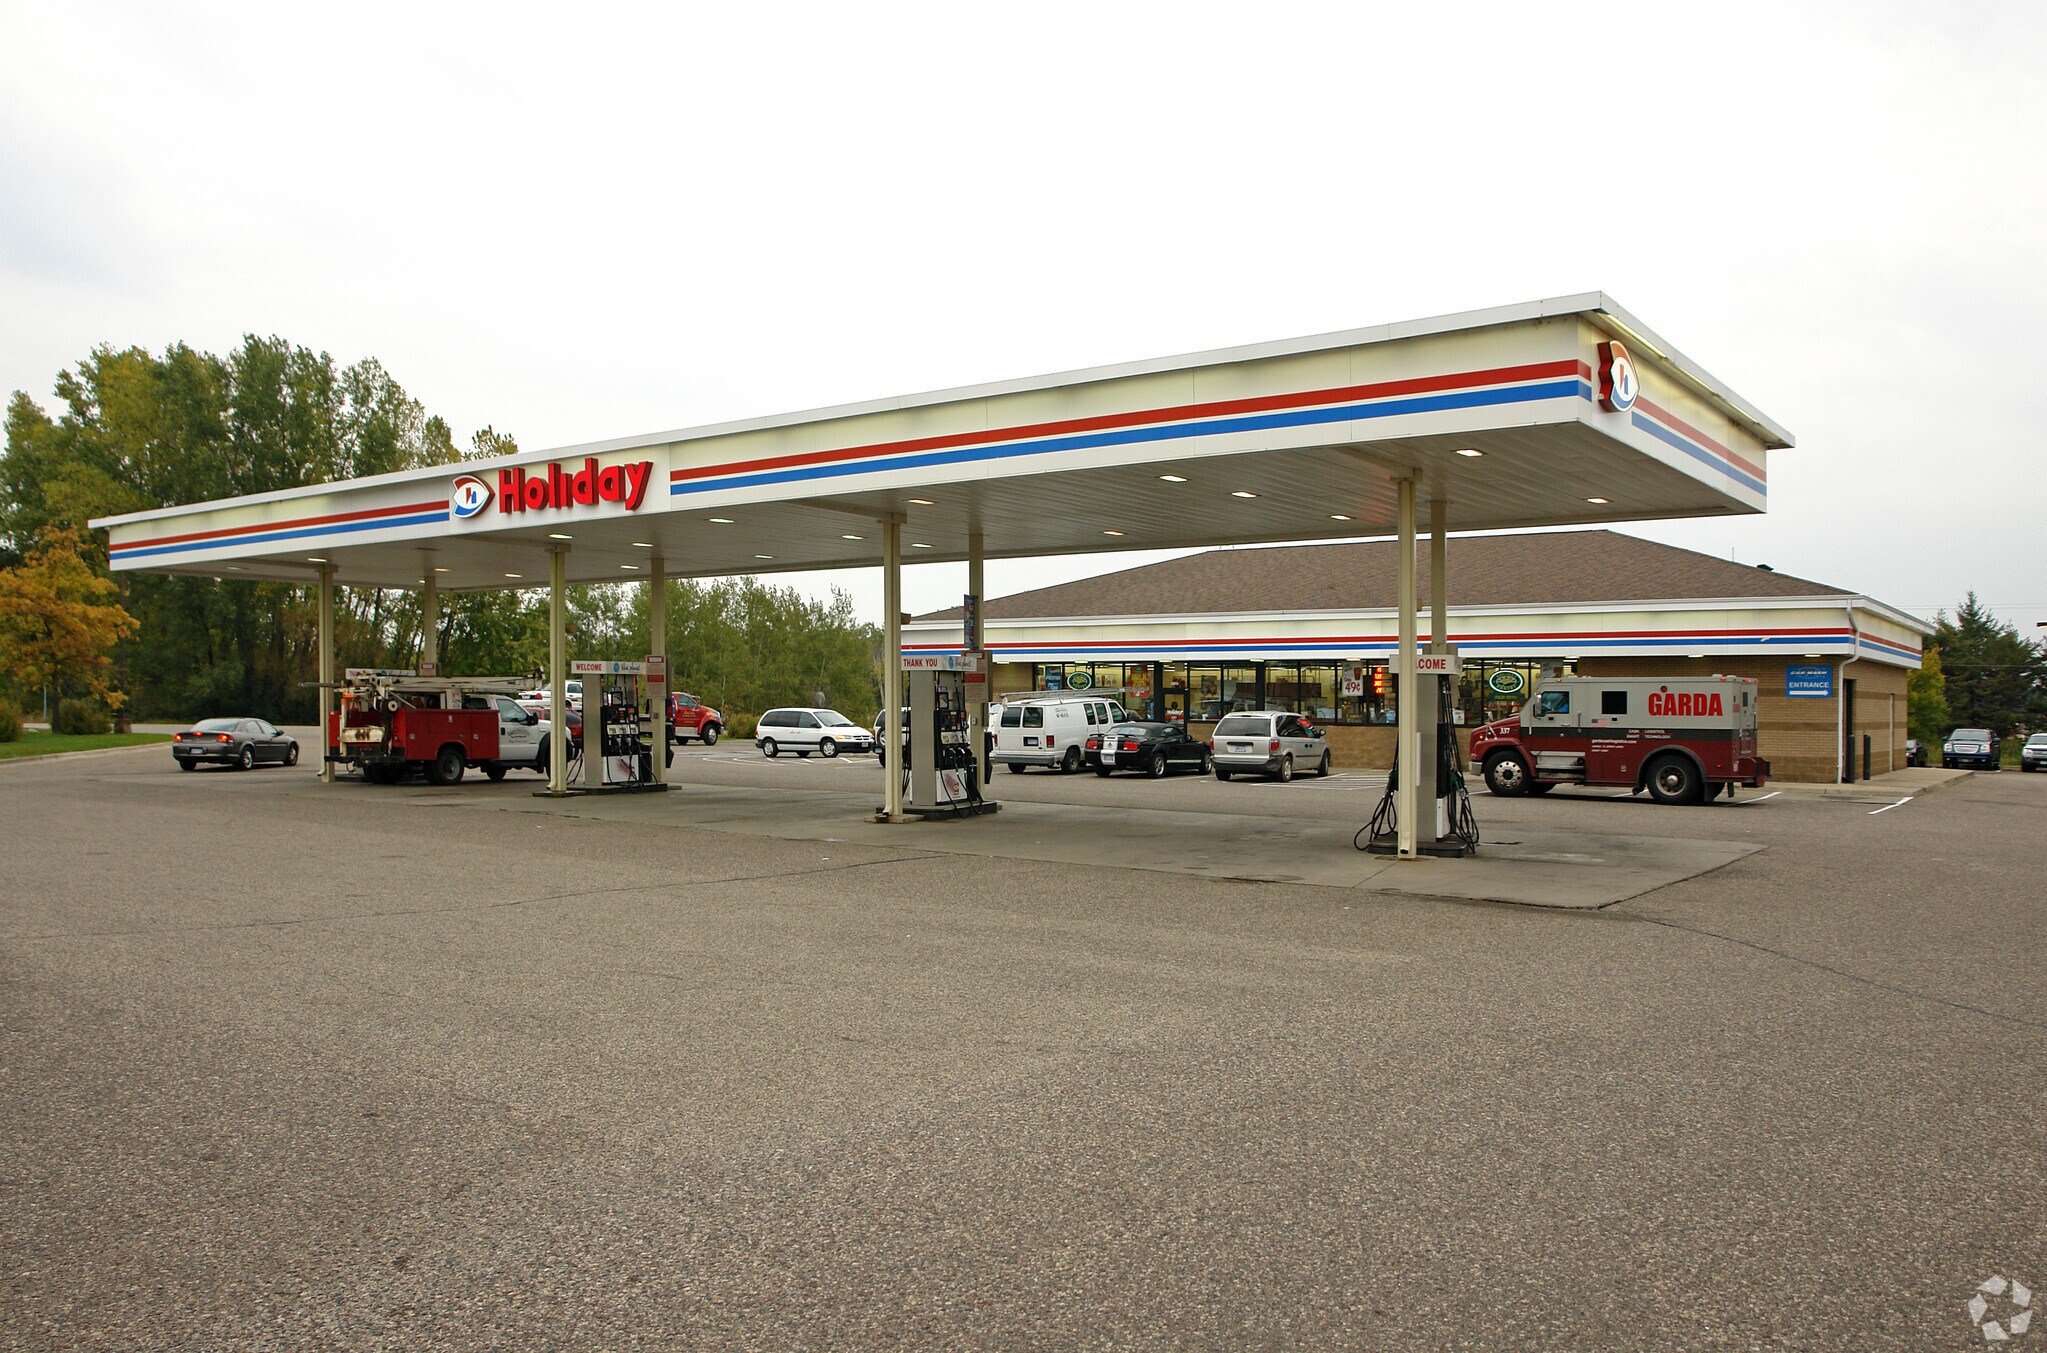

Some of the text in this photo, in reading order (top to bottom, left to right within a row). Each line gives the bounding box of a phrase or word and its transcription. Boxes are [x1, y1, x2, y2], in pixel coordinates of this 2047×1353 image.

[498, 457, 654, 514] Holiday
[575, 663, 602, 671] WELCOME
[903, 658, 938, 668] THANK YOU
[1416, 658, 1447, 670] COME
[1648, 693, 1723, 716] GARDA
